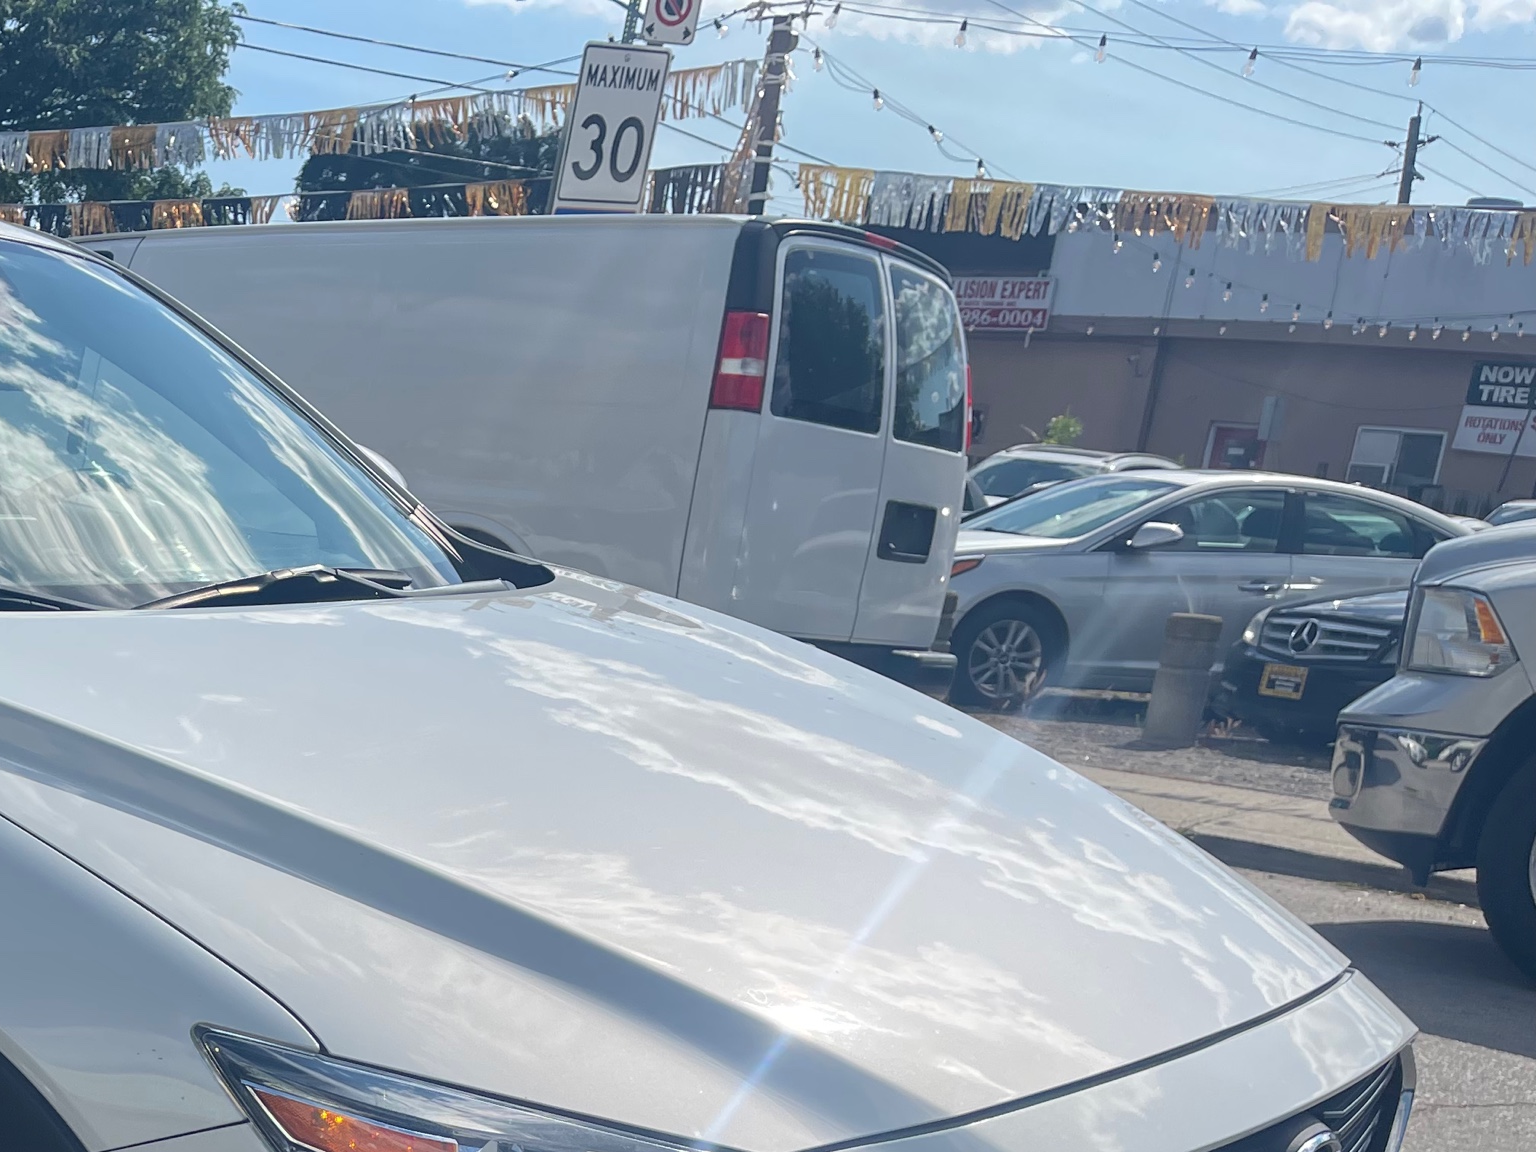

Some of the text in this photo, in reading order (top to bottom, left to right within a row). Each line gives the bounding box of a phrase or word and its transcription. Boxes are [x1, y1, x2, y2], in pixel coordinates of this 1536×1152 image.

[585, 63, 661, 92] MAXIMUM
[572, 113, 645, 183] 30
[954, 279, 1050, 300] LISION EXPERT
[1480, 365, 1536, 384] NOW
[1479, 384, 1531, 405] TIRE
[1477, 432, 1507, 445] ONLY
